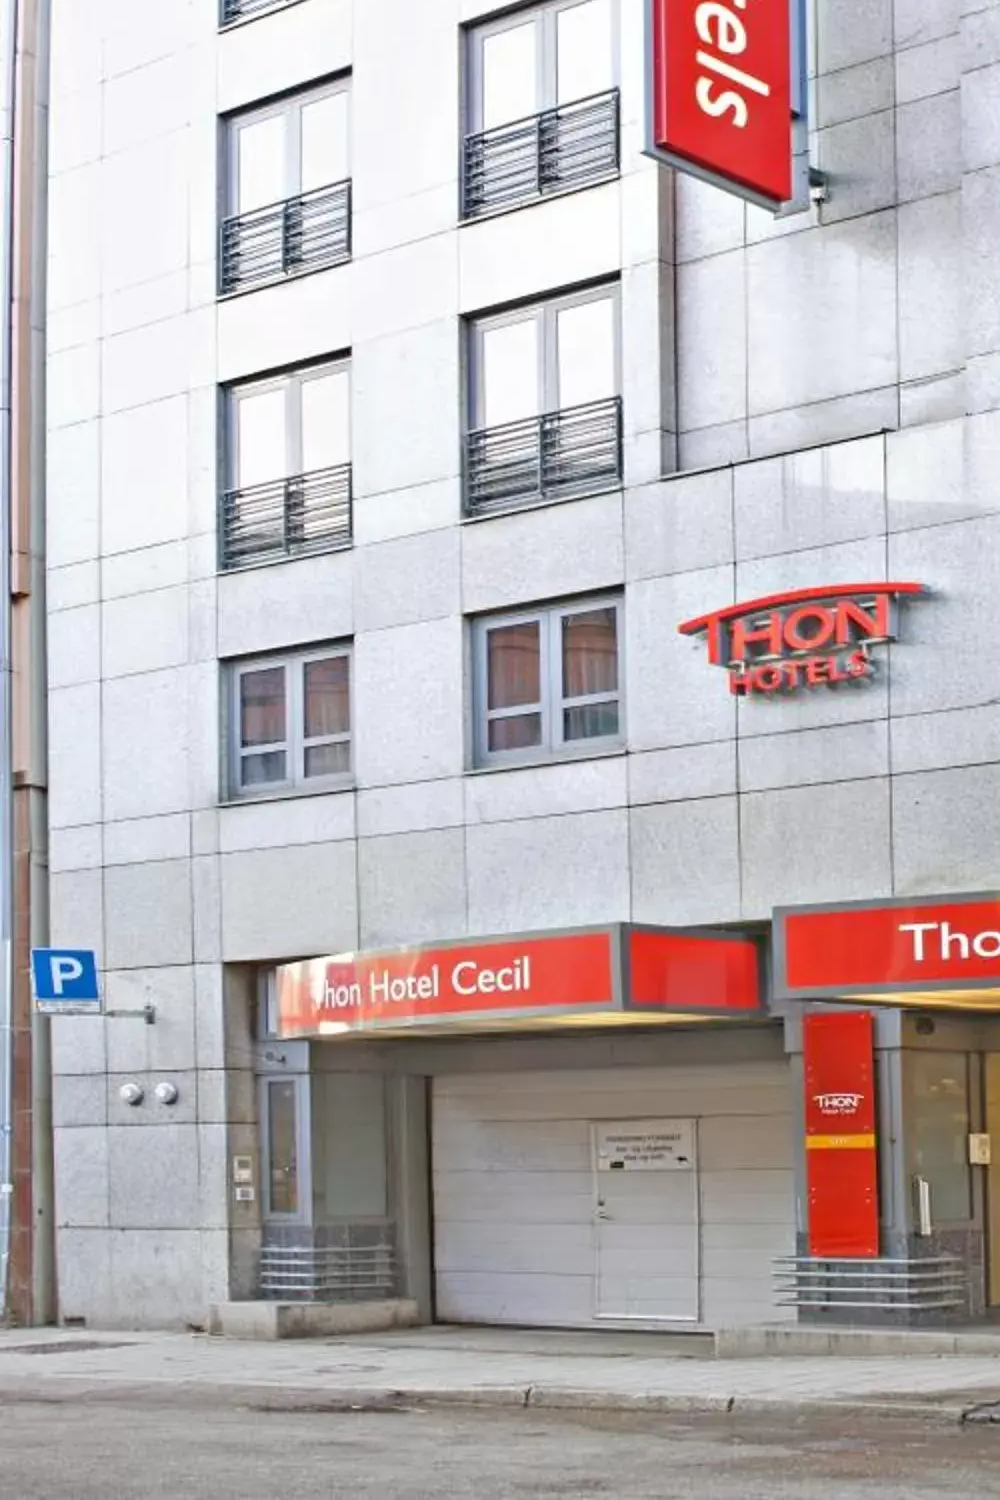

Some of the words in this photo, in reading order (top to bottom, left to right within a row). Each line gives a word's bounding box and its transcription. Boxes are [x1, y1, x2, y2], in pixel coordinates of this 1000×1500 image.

[678, 582, 922, 665] THON
[730, 650, 867, 696] HOTELS
[50, 956, 83, 995] P
[312, 978, 361, 1009] hon
[370, 963, 440, 1004] Hotel
[451, 955, 531, 996] Cecil
[812, 1093, 865, 1108] THON
